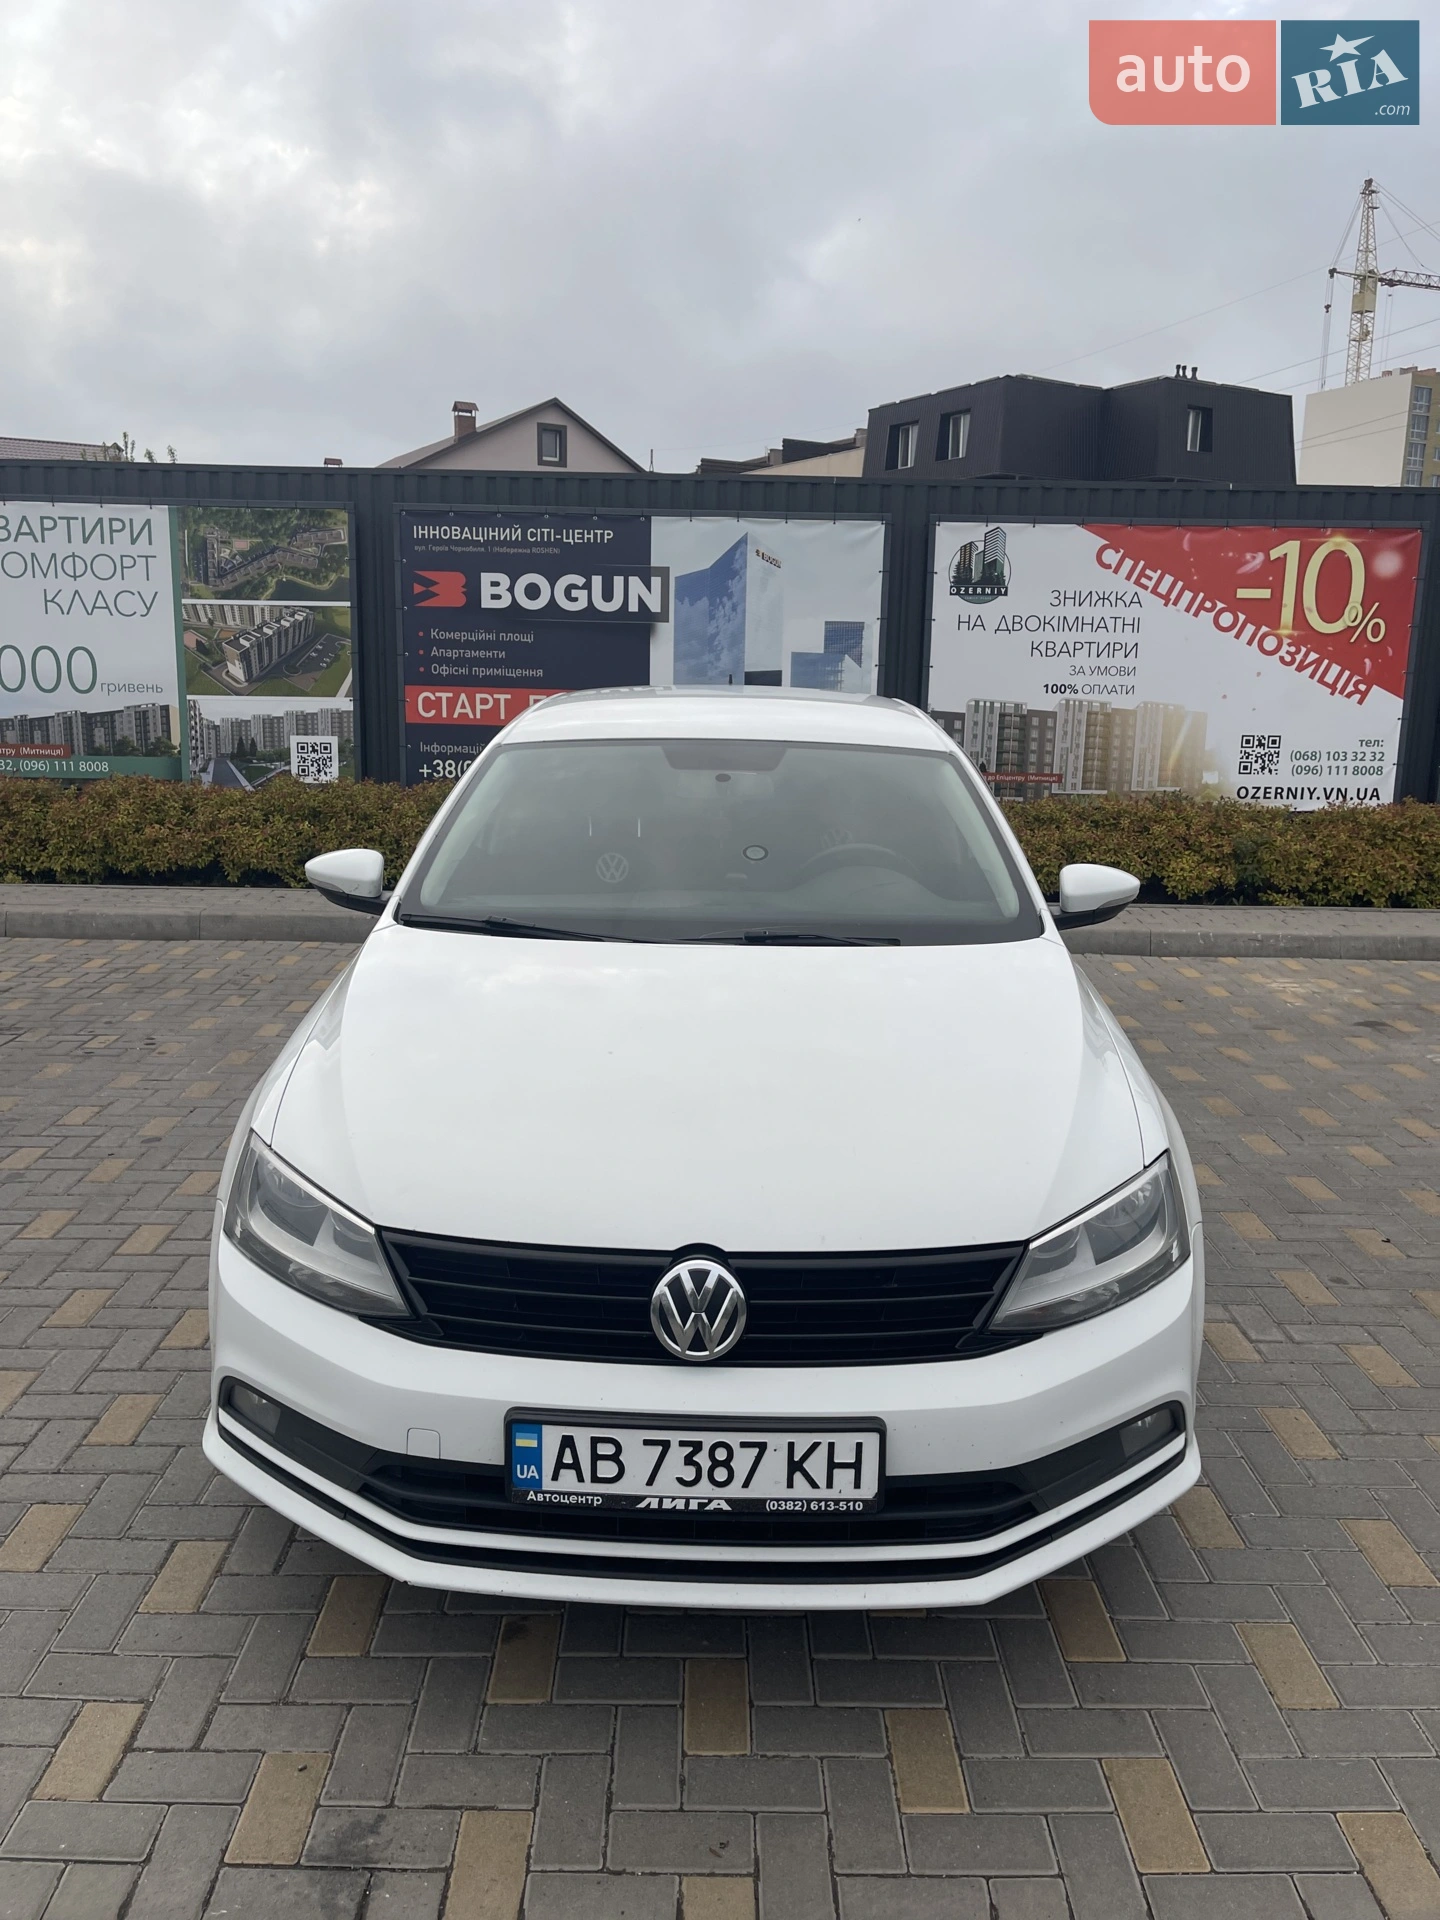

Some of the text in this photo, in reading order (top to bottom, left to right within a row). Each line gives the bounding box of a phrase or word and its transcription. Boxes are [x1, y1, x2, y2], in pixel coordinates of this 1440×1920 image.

[413, 524, 614, 545] ІННОВАЦІНИЙ СІТІ-ЦЕНТР
[1, 551, 157, 582] ОМФОРТ
[480, 572, 662, 613] BOGUN
[950, 587, 1006, 595] OZERNIY
[1049, 589, 1143, 608] ЗНИЖКА
[43, 588, 159, 617] КЛАСУ
[957, 614, 1141, 635] НА ДВОКІМНАТНІ
[1095, 542, 1375, 706] СПЕЦПРОПОЗИЦІЯ
[430, 628, 534, 643] Комерційні площі
[430, 647, 506, 660] Апартаменти
[1030, 640, 1139, 659] КВАРТИРИ
[431, 664, 544, 678] Офісні приміщення
[1069, 665, 1137, 676] ЗА УМОВИ
[101, 682, 164, 696] гривень
[1043, 683, 1136, 695] 100% ОПЛАТИ
[417, 691, 512, 720] СТАРТ
[20, 746, 64, 757] (Митниця)
[1358, 739, 1384, 748] тел:
[1290, 750, 1385, 763] (068) 103 32 32
[20, 760, 50, 773] (096)
[54, 761, 74, 771] 111
[79, 761, 109, 772] 8008
[1291, 764, 1384, 777] (096) 111 8008
[1236, 785, 1381, 801] OZERNIY.VN.UA
[550, 1434, 864, 1490] AB 7387 KH
[516, 1464, 540, 1480] UA
[527, 1490, 864, 1512] Автоцентр ЛИГА (0382) 613-510
